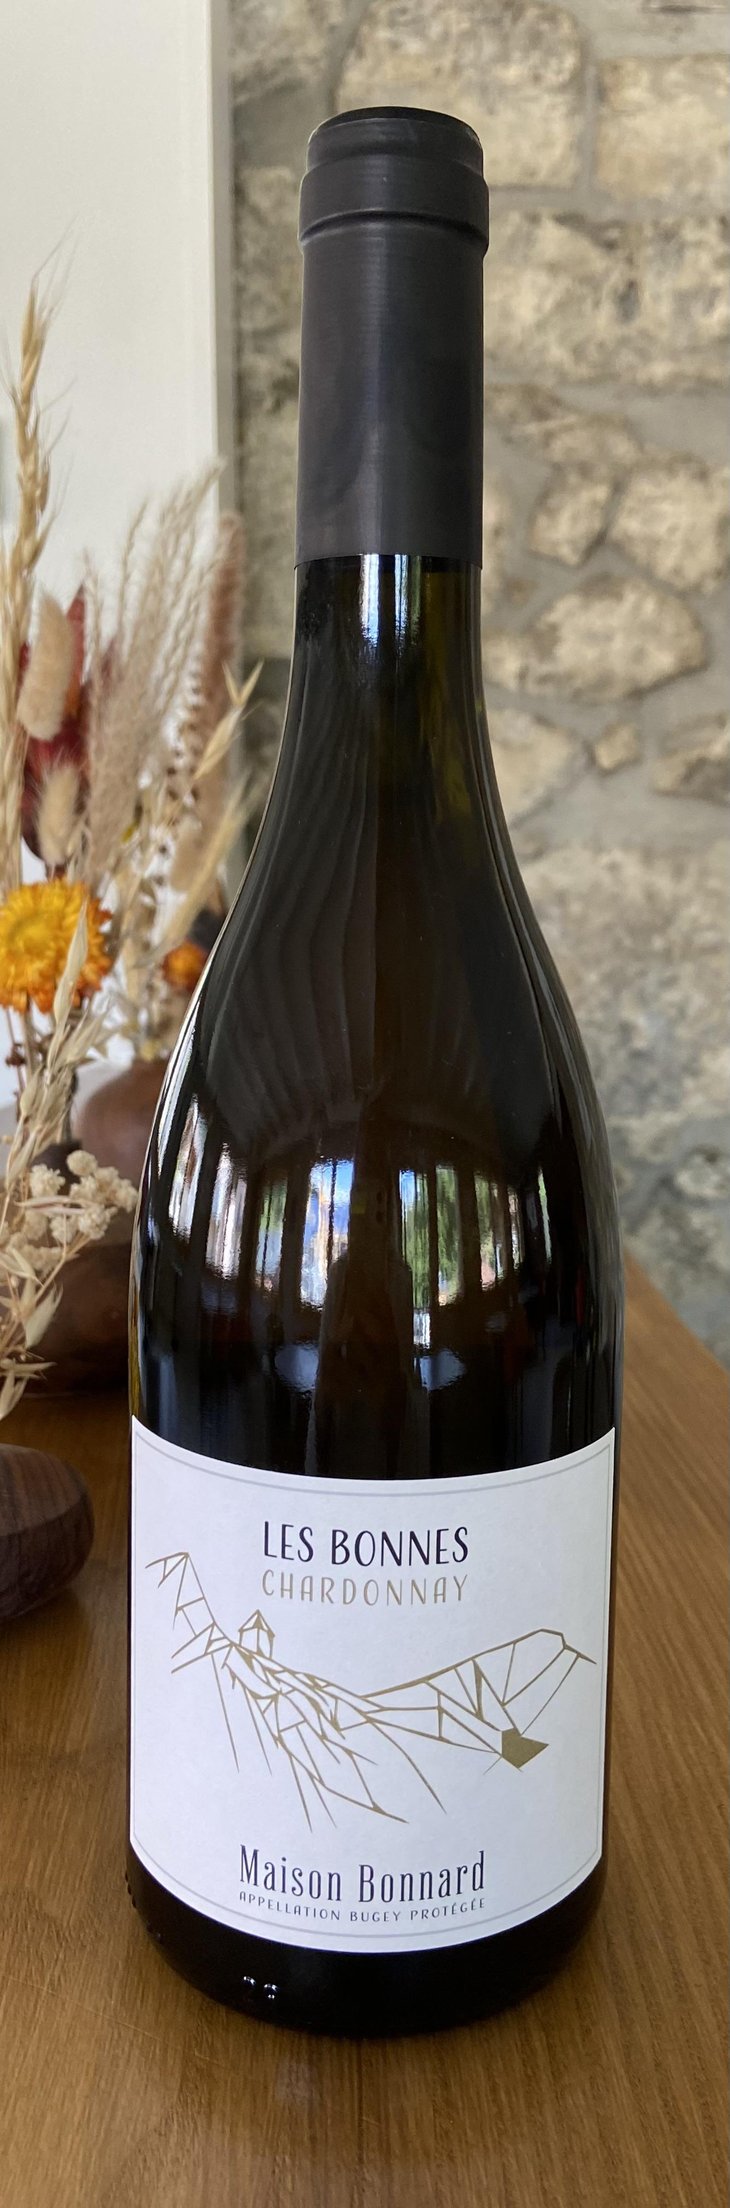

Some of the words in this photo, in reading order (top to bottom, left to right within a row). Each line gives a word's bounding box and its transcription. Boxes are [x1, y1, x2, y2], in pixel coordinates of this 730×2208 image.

[264, 1521, 314, 1563] LES
[331, 1526, 469, 1567] BONNES
[262, 1569, 468, 1606] CHARDONNAY
[239, 1844, 342, 1902] Maison
[358, 1850, 485, 1903] Bonnard
[239, 1891, 341, 1921] APPELLATION
[350, 1911, 402, 1923] BUGEY
[410, 1897, 486, 1921] PROTÉGÉE
